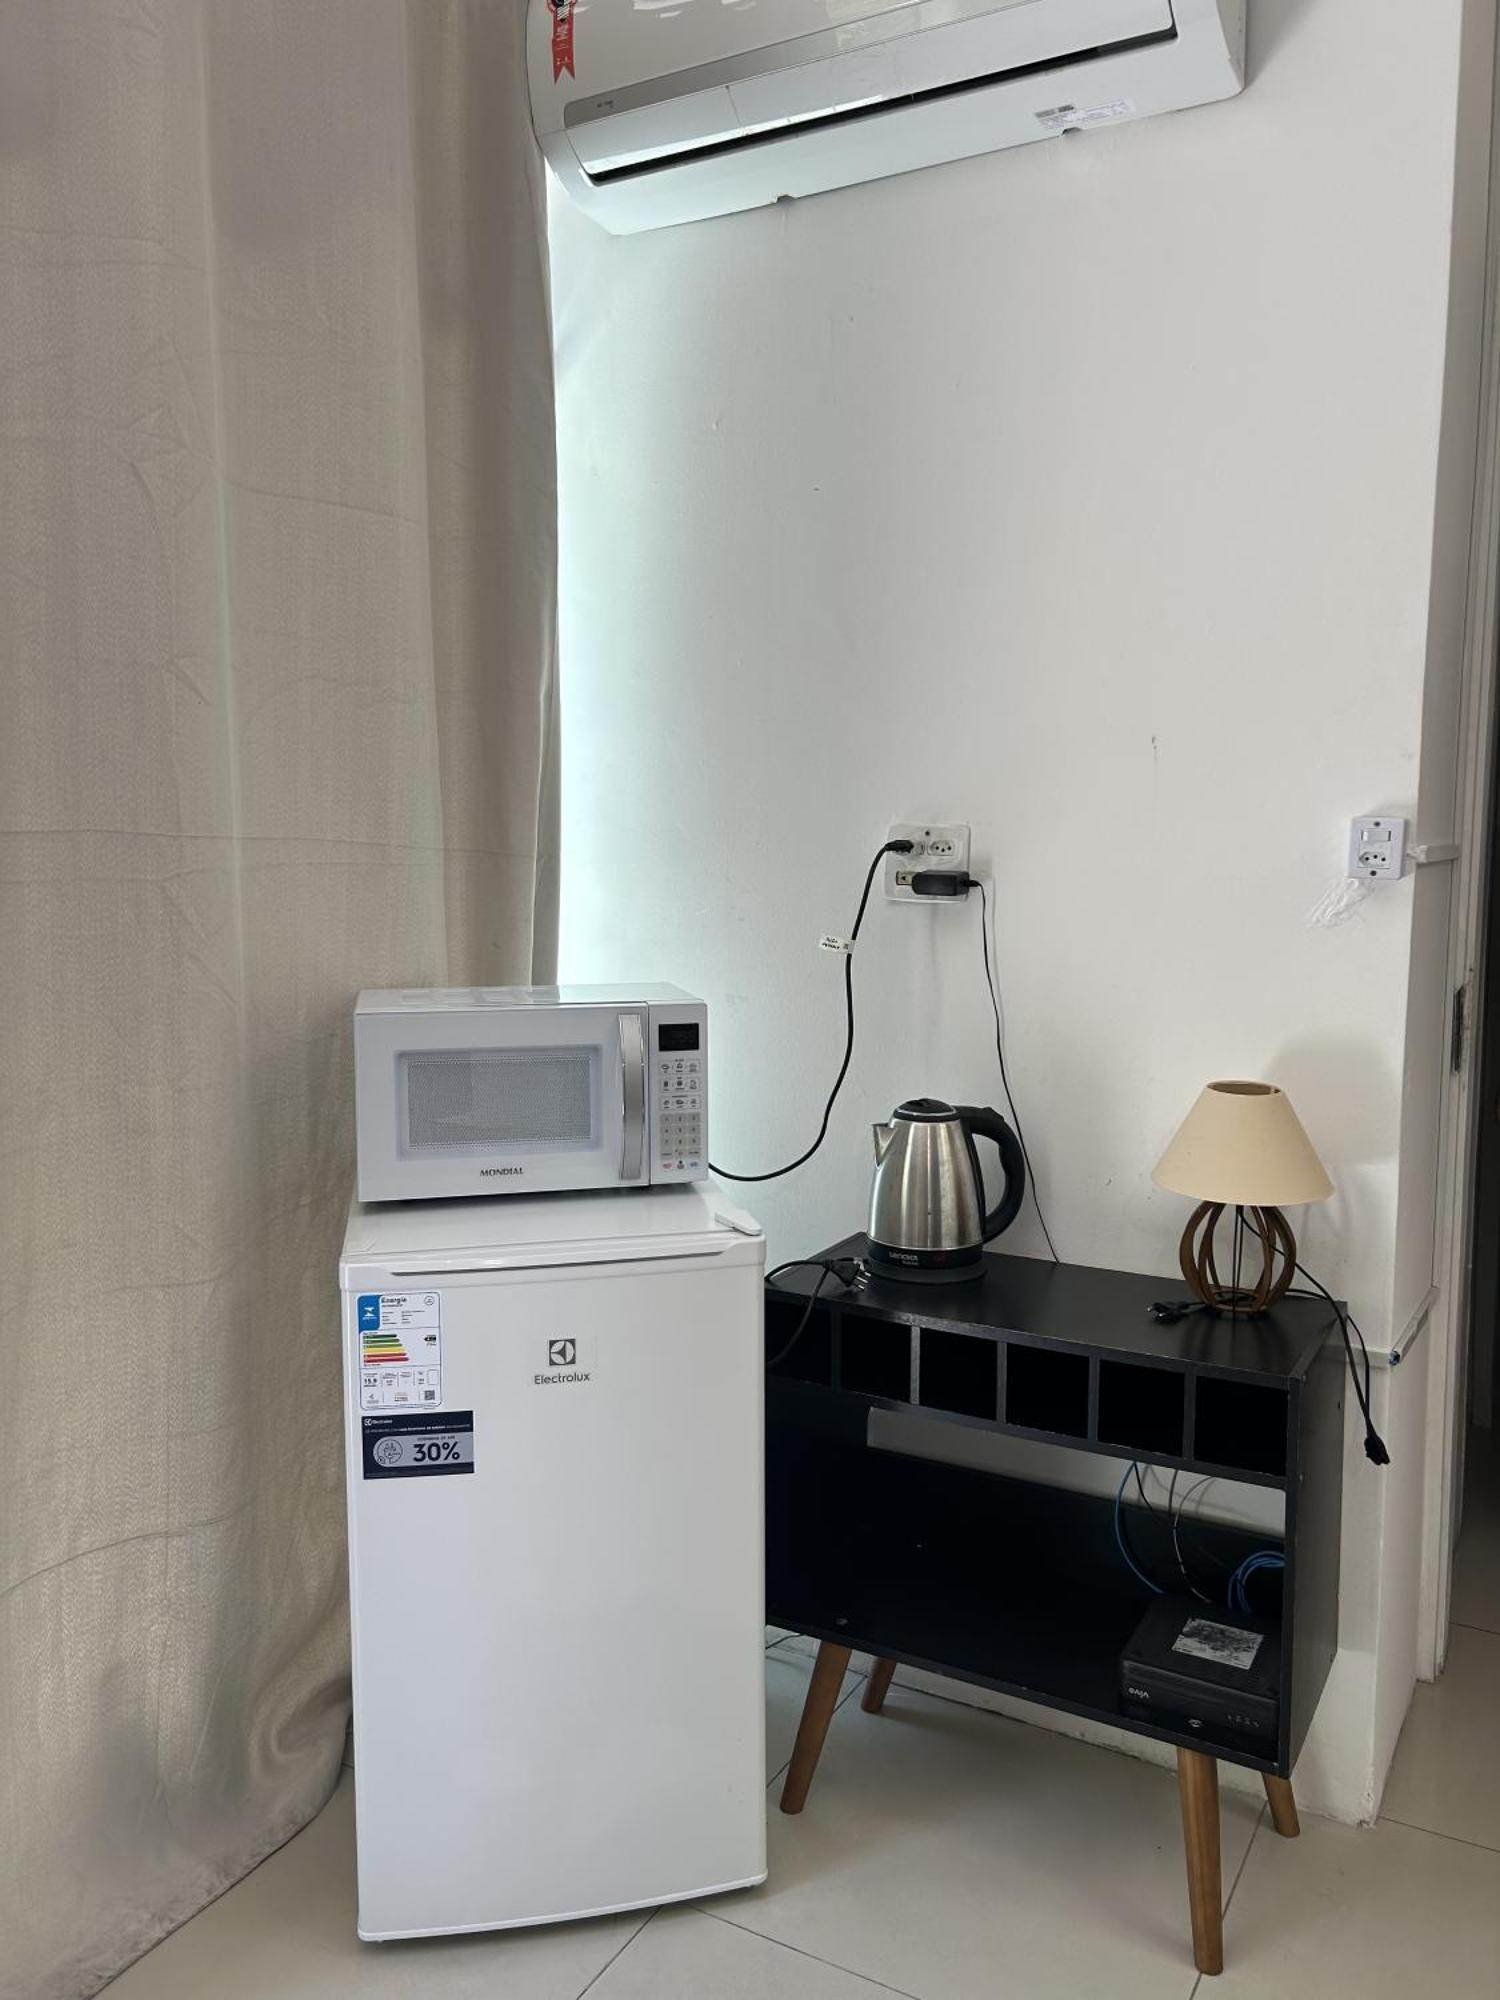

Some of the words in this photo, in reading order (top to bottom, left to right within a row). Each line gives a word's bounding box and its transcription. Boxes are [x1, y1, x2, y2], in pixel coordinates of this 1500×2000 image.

[480, 1168, 524, 1176] MONDIAL
[534, 1372, 590, 1385] Electrolux
[413, 1441, 461, 1463] 30%
